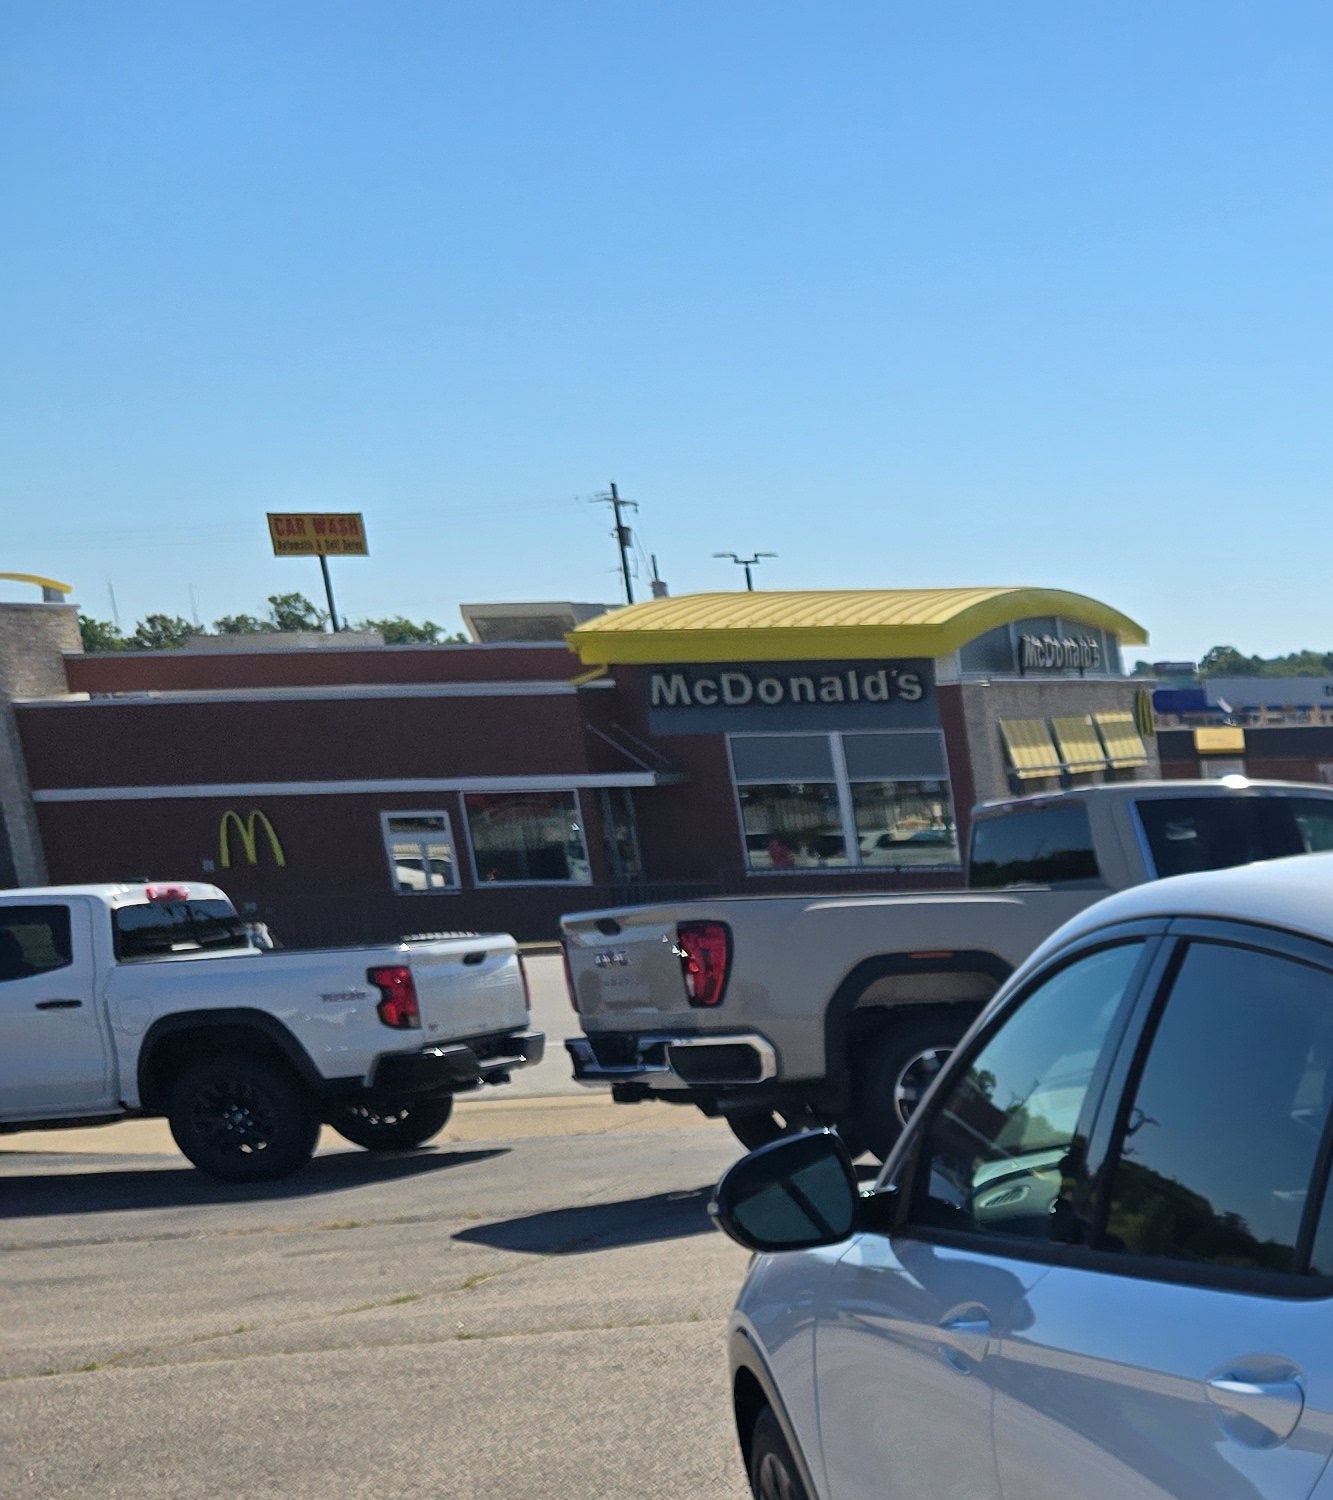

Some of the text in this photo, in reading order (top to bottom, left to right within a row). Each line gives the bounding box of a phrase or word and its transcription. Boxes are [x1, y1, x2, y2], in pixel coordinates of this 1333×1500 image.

[273, 517, 360, 537] CAR WASH
[1022, 632, 1100, 668] McDonald's
[651, 668, 924, 706] McDonald's
